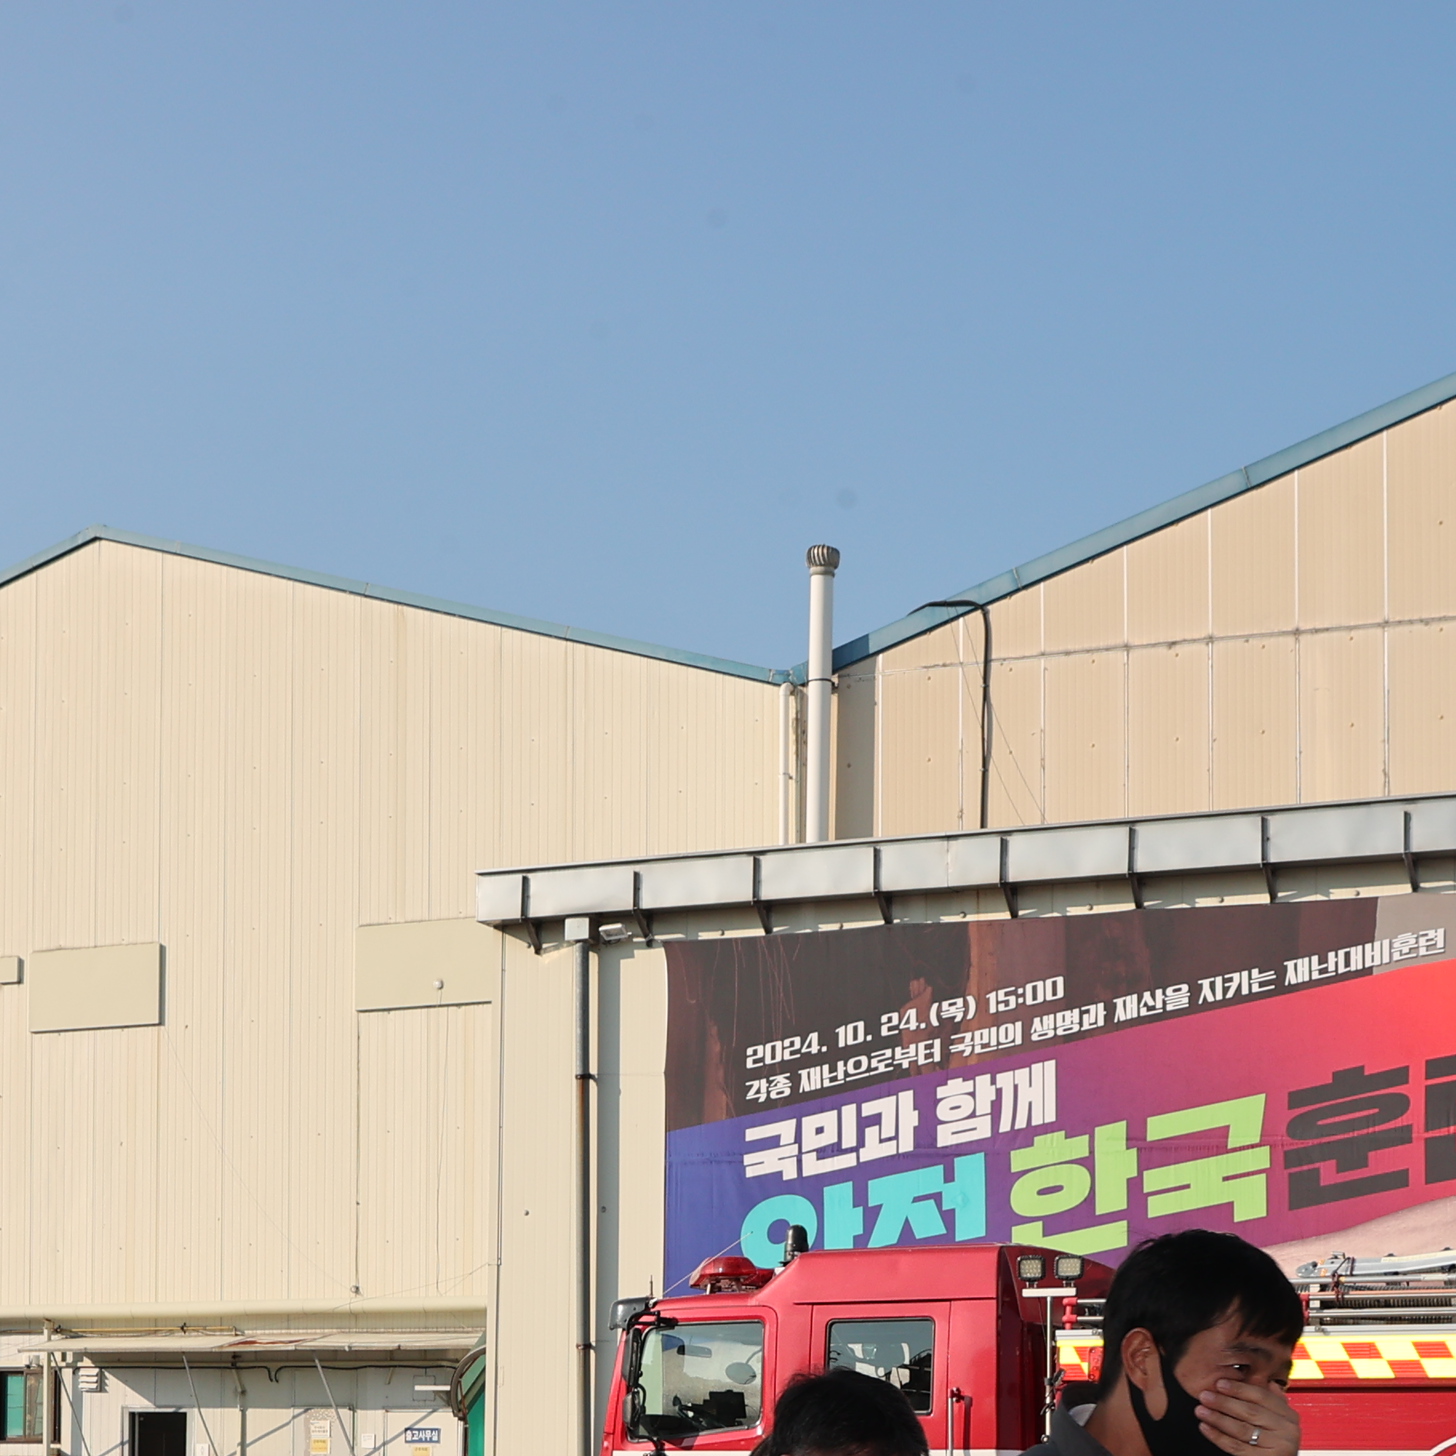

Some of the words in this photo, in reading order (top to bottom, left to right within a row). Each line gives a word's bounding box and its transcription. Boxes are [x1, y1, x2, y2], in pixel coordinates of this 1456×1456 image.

[744, 1072, 793, 1104] 각종
[798, 1037, 942, 1094] 재난으로부터
[948, 1020, 1023, 1057] 국민의
[1030, 1002, 1107, 1043] 생명과
[1112, 983, 1191, 1024] 재산을
[1197, 967, 1277, 1006] 지키는
[1283, 927, 1446, 987] 재난대비훈련
[745, 1031, 828, 1070] 2024.
[834, 1020, 873, 1049] 10.
[985, 975, 1065, 1015] 15:00
[743, 1089, 919, 1182] 국민과
[934, 1059, 1057, 1149] 함께
